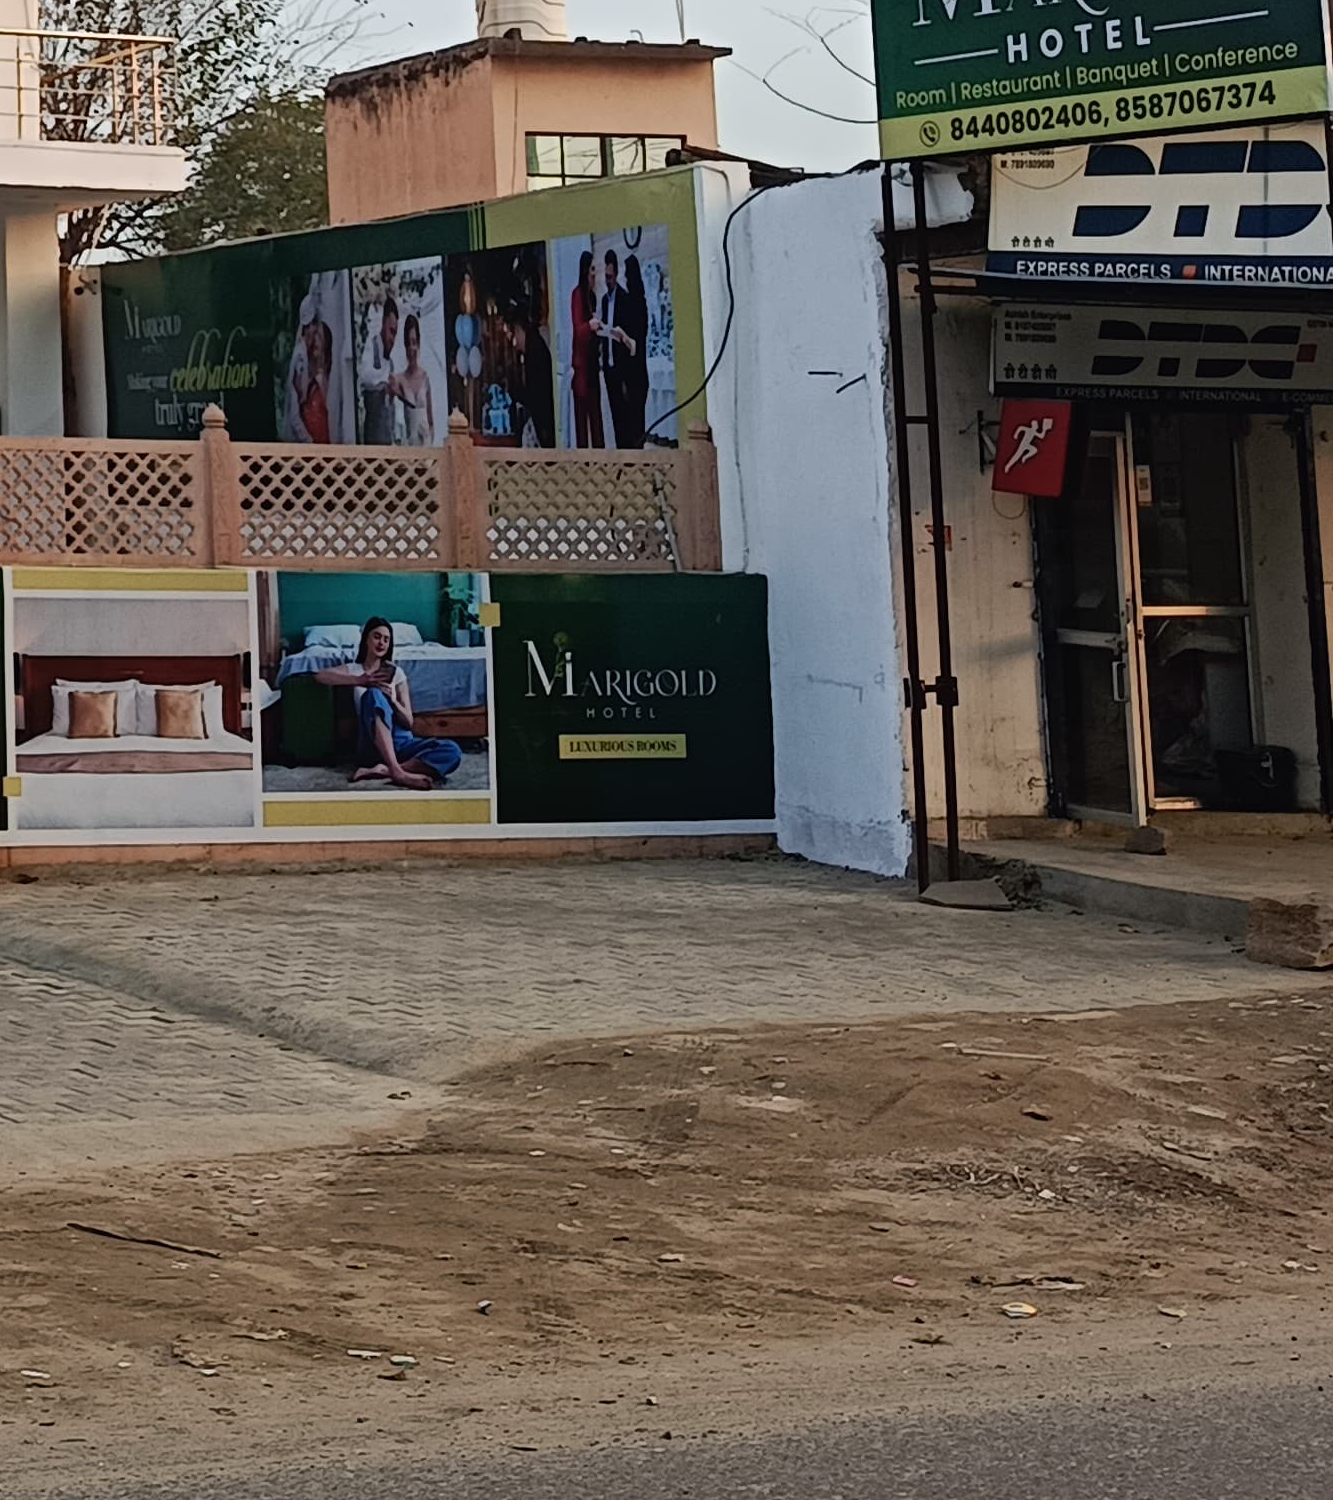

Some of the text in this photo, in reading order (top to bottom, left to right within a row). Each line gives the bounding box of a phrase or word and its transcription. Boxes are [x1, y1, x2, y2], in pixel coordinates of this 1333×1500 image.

[1006, 16, 1151, 63] HOTEL
[895, 40, 1299, 109] Room Restaurant Banquet Conference
[950, 80, 1276, 142] 8440802406, 8587067374
[1016, 260, 1090, 277] EXPRESS
[1094, 263, 1171, 280] PARCELS
[170, 325, 258, 392] celebrations
[1091, 320, 1301, 380] DTDC
[155, 392, 184, 431] truly
[1056, 387, 1107, 399] EXPRESS
[1108, 389, 1159, 401] PARCELS
[1179, 390, 1262, 402] INTERNATIONAL
[522, 640, 717, 705] MARIGOLD
[586, 707, 656, 719] HOTEL
[569, 740, 677, 753] LUXURIOUS ROOMS
